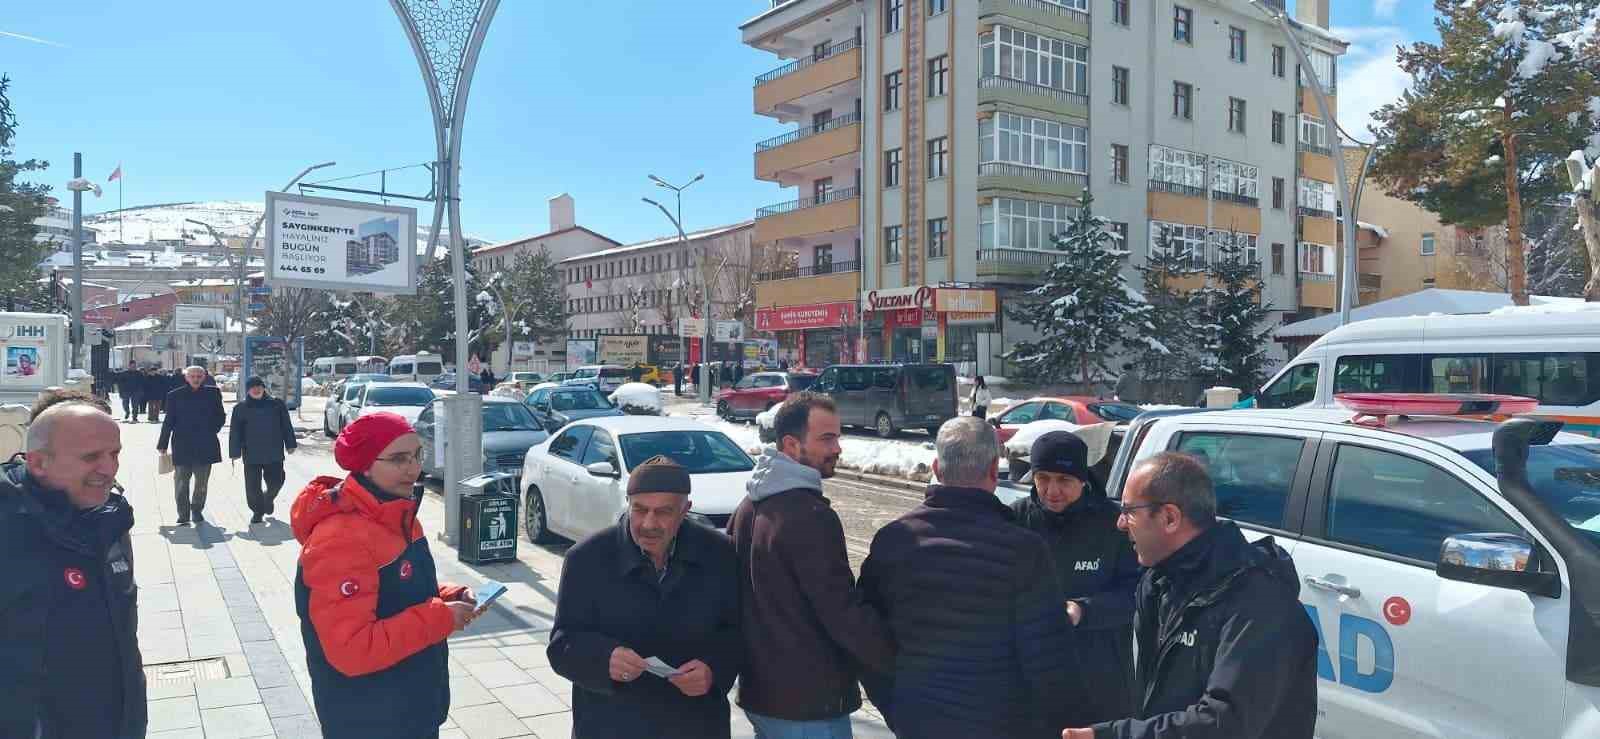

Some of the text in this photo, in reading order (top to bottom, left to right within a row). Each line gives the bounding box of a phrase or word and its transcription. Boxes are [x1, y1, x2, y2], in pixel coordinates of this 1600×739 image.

[282, 222, 354, 235] SAYGINKENT'TE
[282, 241, 320, 253] BUGÜN
[280, 264, 298, 272] 444
[868, 290, 912, 311] SULTAN
[1074, 560, 1100, 571] AFAD
[1177, 631, 1195, 647] AD
